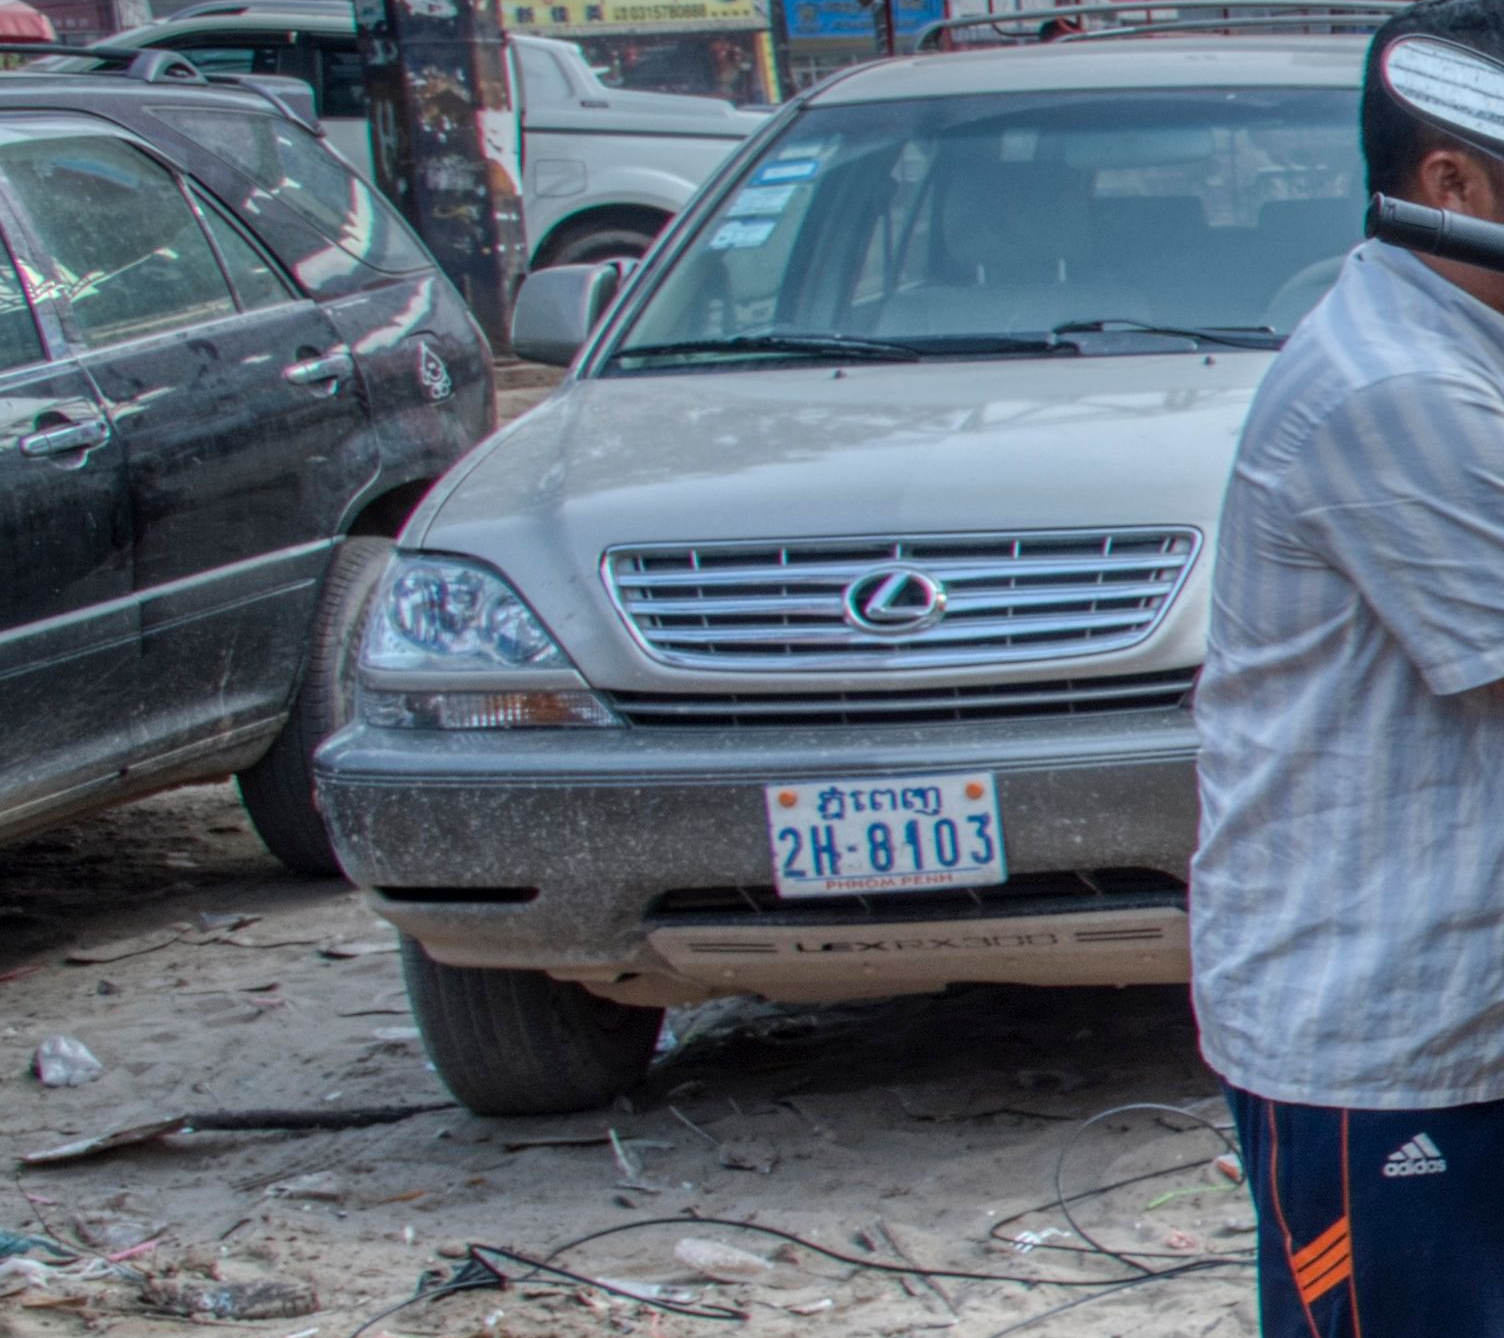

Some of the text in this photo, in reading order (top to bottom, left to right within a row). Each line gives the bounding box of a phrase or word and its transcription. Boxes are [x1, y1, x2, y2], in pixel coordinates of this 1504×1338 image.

[777, 811, 996, 879] 2H-8103
[825, 873, 954, 891] PHNOM PENH
[1382, 1158, 1447, 1177] adidas
